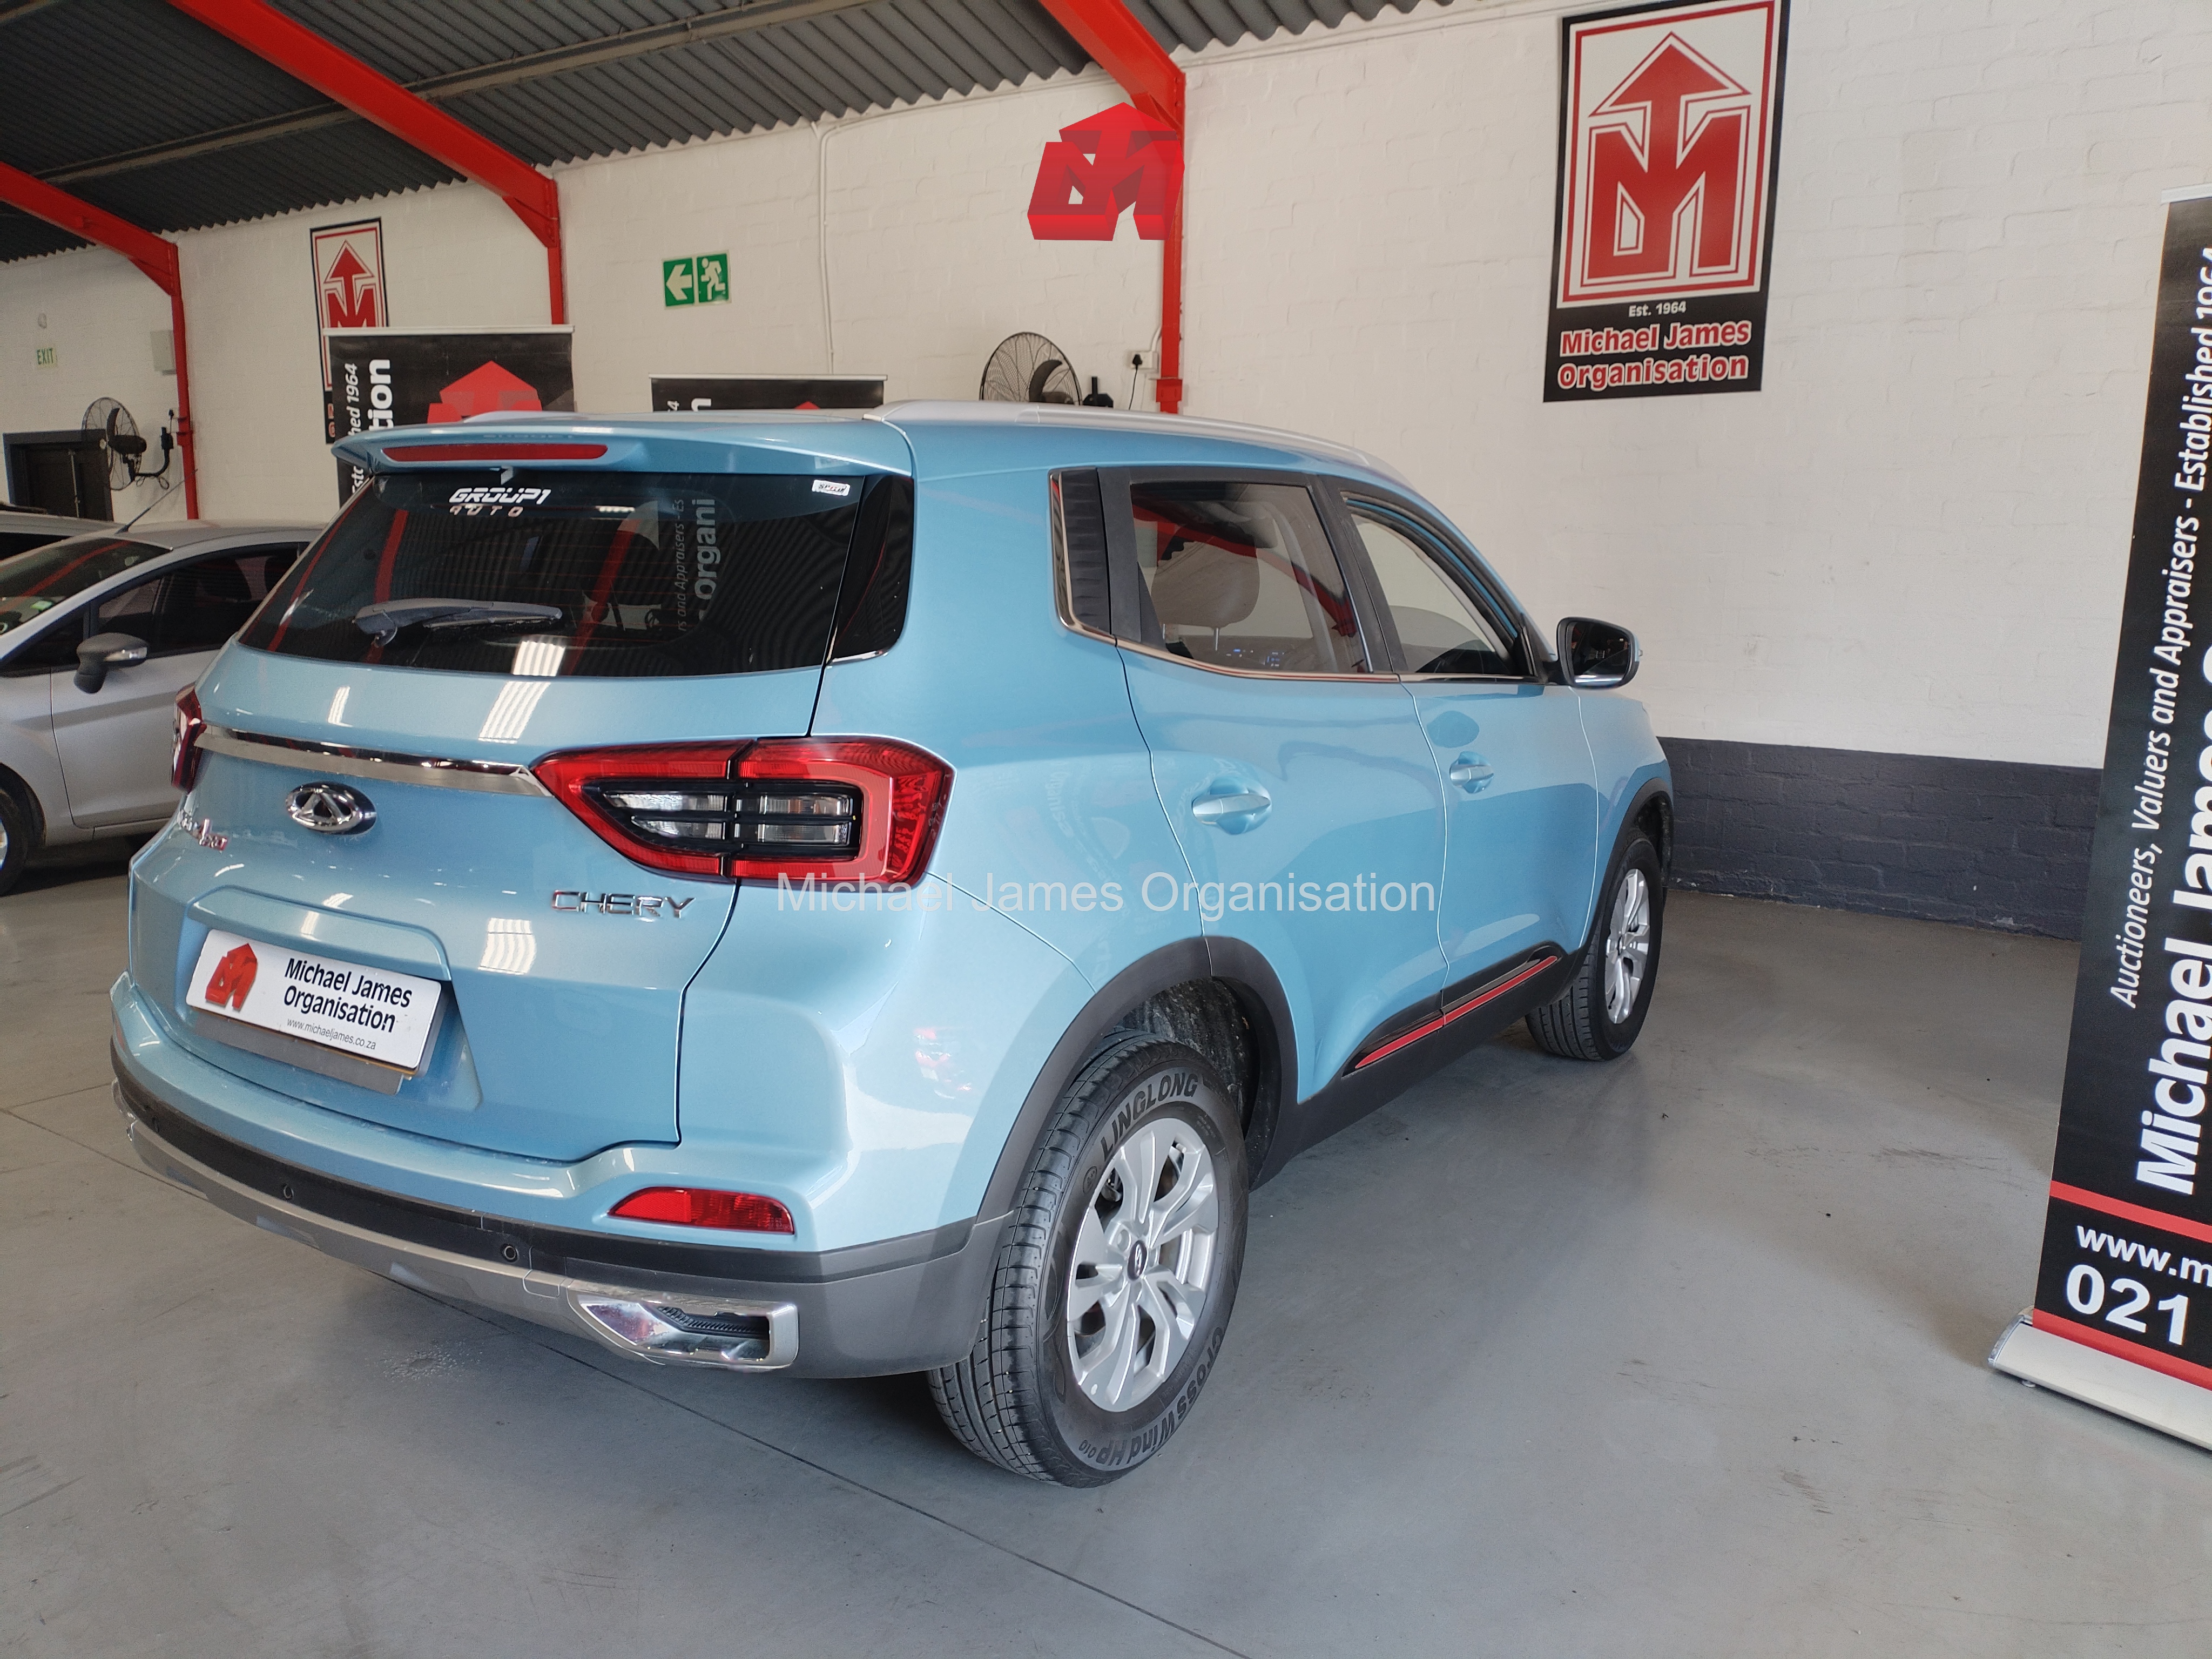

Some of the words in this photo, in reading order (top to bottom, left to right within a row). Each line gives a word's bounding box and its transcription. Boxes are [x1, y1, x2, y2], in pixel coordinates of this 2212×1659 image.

[1628, 305, 1651, 318] Est.
[1656, 300, 1687, 315] 1964
[37, 347, 53, 365] EXIT
[1559, 324, 1660, 357] Michael
[1663, 320, 1752, 350] James
[345, 363, 360, 403] 1964
[1557, 353, 1749, 392] Organisation
[2174, 327, 2212, 492] Established
[449, 487, 551, 505] GROUP1
[675, 522, 689, 590] Appraisers
[677, 592, 686, 617] and
[2154, 515, 2201, 666] Appraisers
[2149, 667, 2180, 725] and
[2131, 730, 2171, 831] Valuers
[551, 889, 696, 919] CHERY
[2109, 844, 2162, 1009] Auctioneers,
[284, 957, 352, 992] Michael
[352, 974, 413, 1008] James
[284, 985, 395, 1033] Organisation
[287, 1017, 376, 1050] www.michaeljames.co.za
[2135, 937, 2212, 1196] Michael
[1101, 1071, 1199, 1161] LINGLONG
[2066, 1264, 2190, 1347] 021
